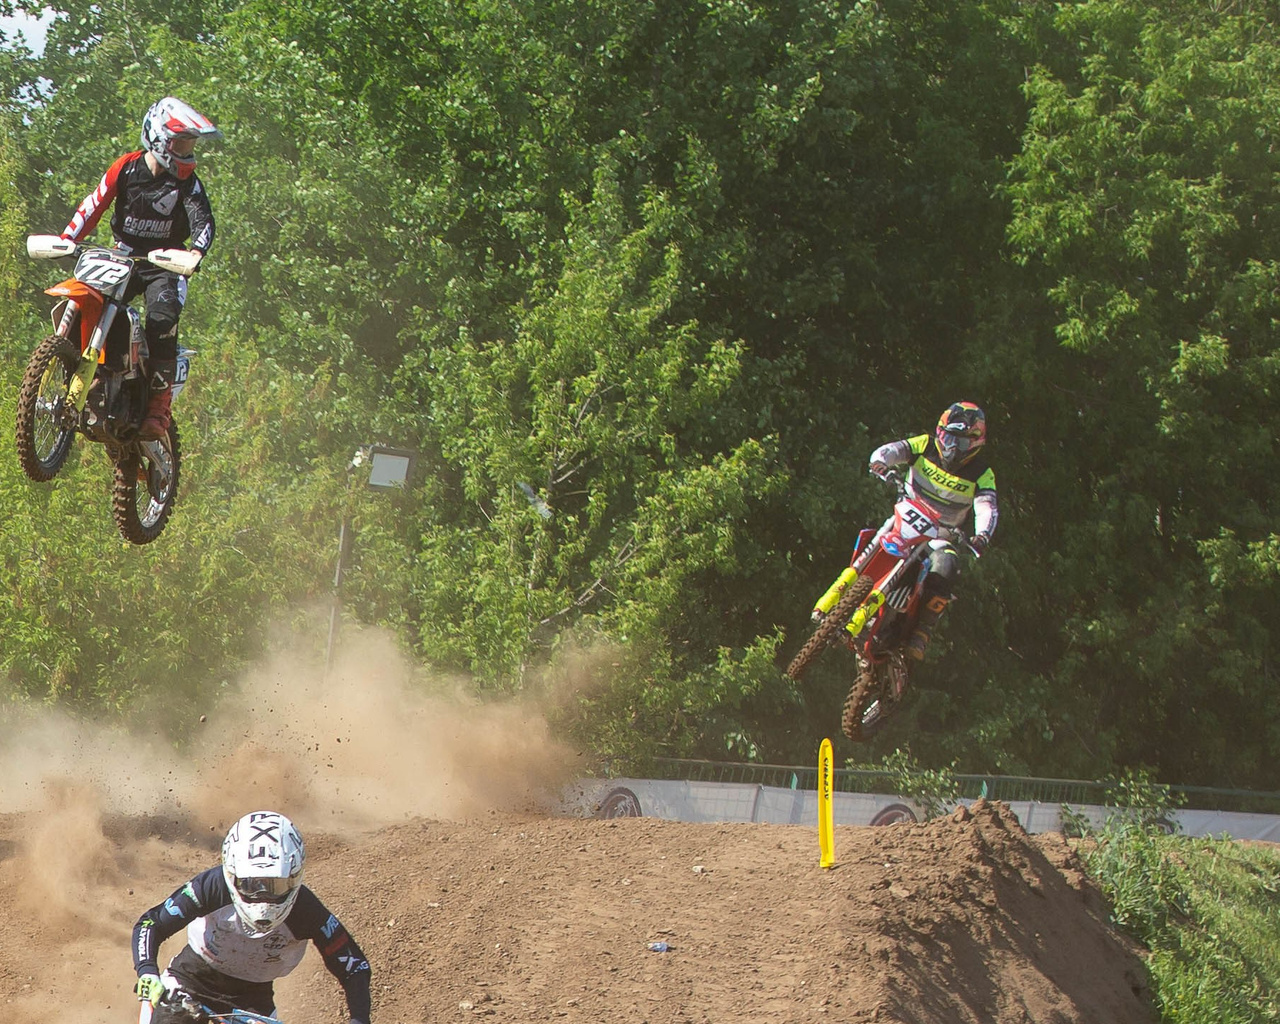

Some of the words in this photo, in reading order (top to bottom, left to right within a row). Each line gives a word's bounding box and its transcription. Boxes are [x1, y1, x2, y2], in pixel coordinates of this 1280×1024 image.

[124, 216, 174, 232] СБОРНАЯ
[75, 258, 130, 285] 772
[902, 509, 933, 534] 93
